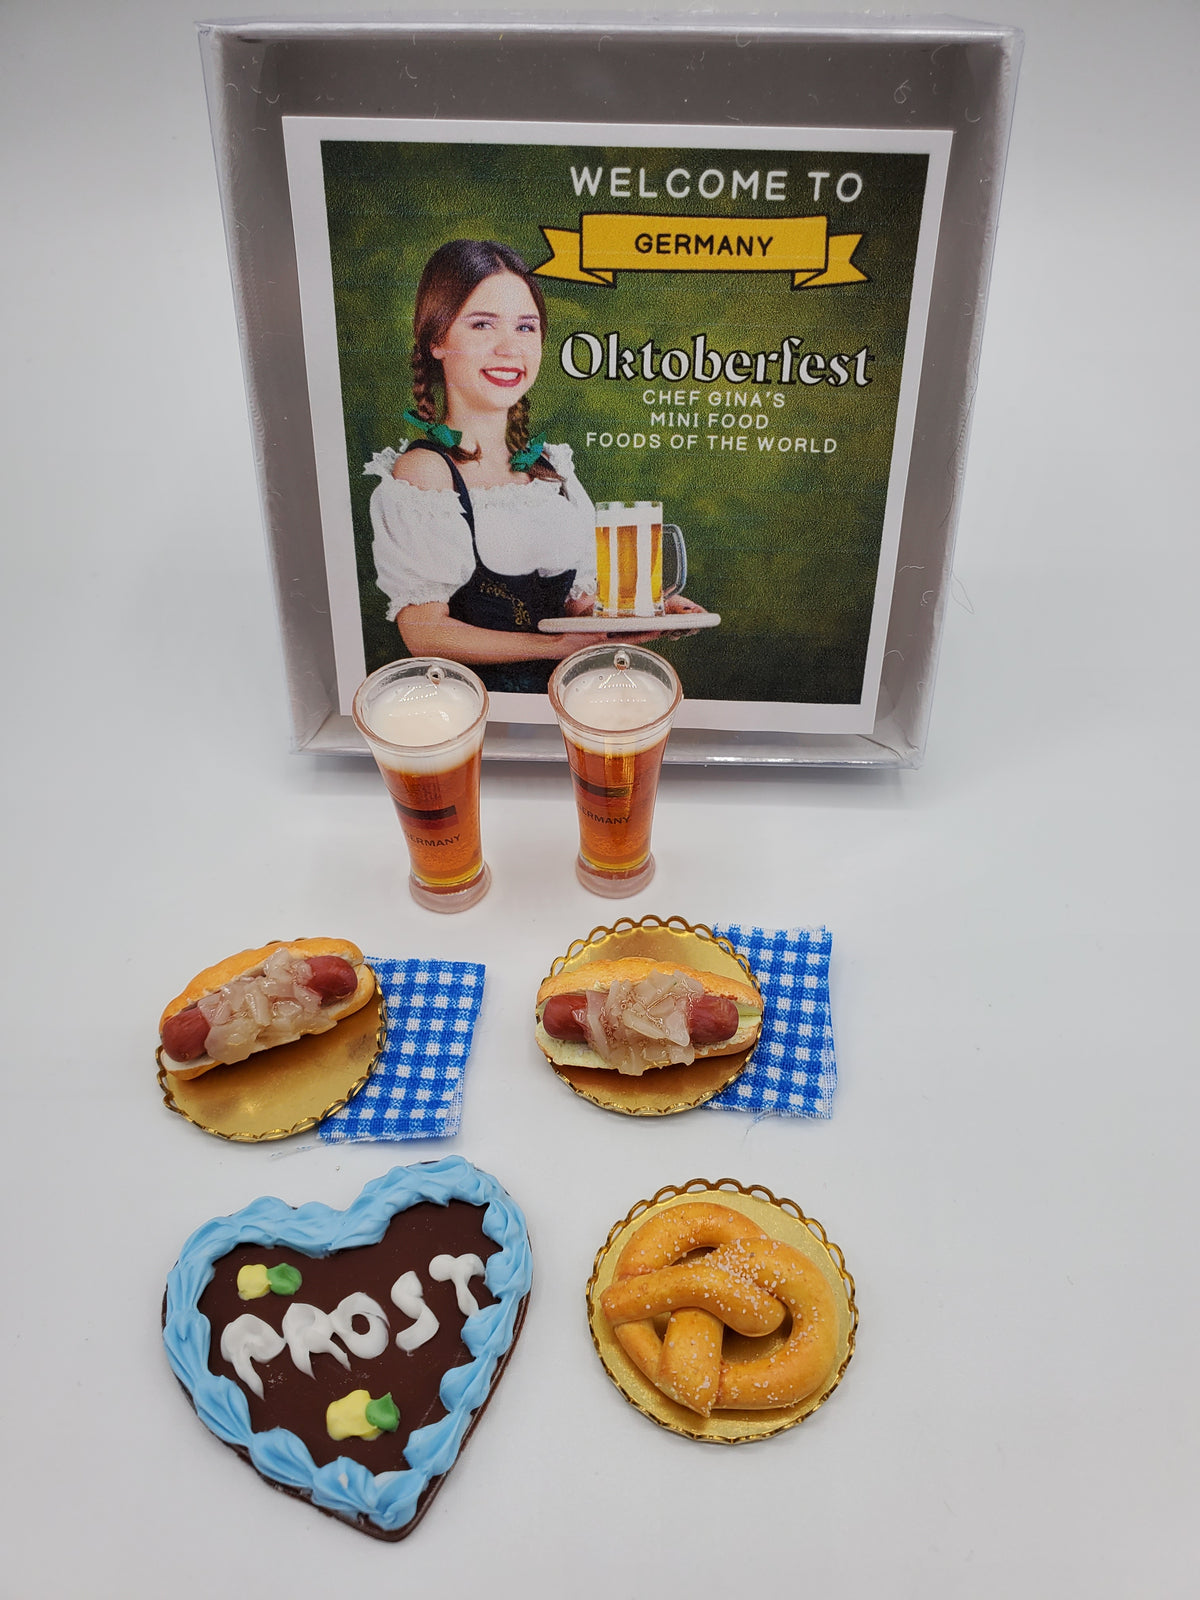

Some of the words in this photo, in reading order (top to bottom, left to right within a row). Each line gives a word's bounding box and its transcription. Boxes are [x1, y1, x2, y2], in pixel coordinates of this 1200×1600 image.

[570, 165, 788, 201] WELCOME
[808, 171, 863, 202] TO
[634, 233, 774, 257] GERMANY
[560, 331, 875, 387] Oktoberfest
[642, 389, 701, 406] CHEF
[708, 391, 786, 408] GINA'S
[650, 411, 700, 428] MINI
[707, 411, 769, 430] FOOD
[586, 432, 661, 449] FOODS
[670, 434, 698, 450] OF
[707, 436, 748, 452] THE
[757, 437, 838, 454] WORLD
